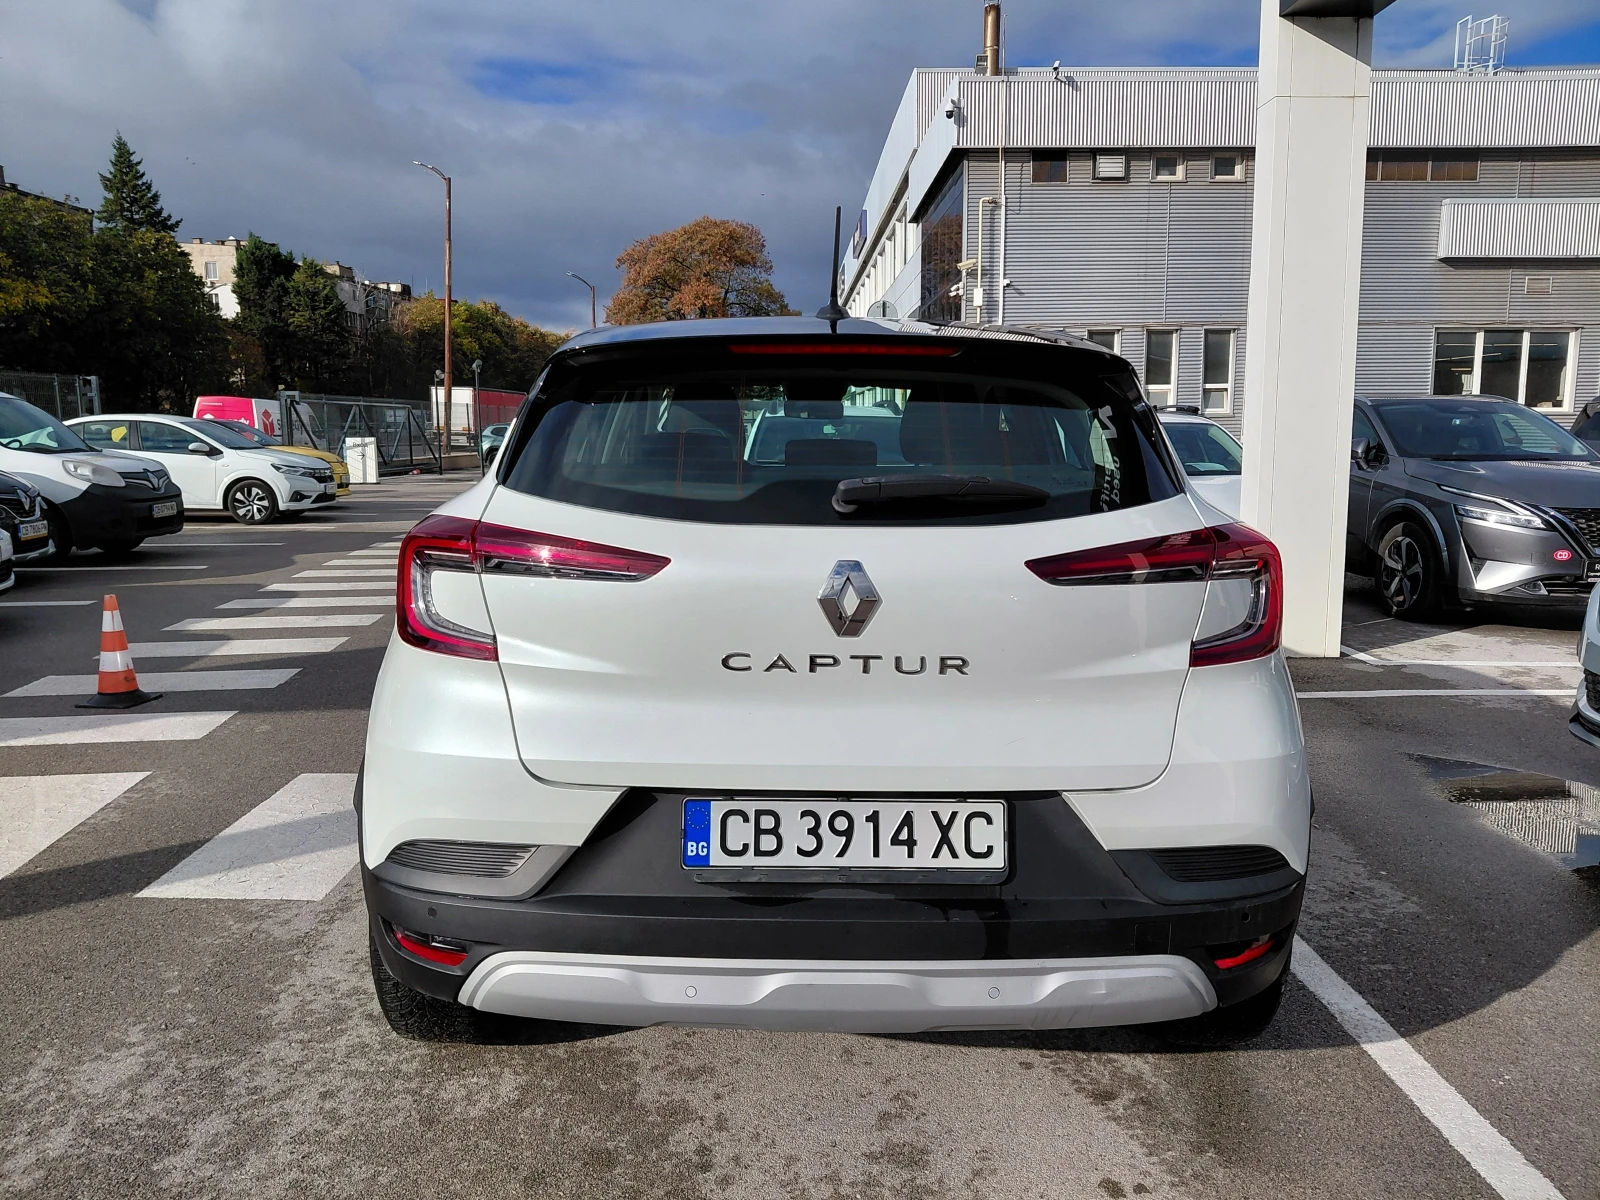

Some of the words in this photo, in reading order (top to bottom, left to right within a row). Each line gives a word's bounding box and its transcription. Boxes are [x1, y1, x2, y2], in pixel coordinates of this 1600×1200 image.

[1557, 551, 1569, 559] CD
[721, 651, 970, 676] CAPTUR
[719, 808, 783, 858] CB
[796, 810, 918, 859] 3914
[931, 810, 994, 859] XC
[687, 841, 708, 857] BG
